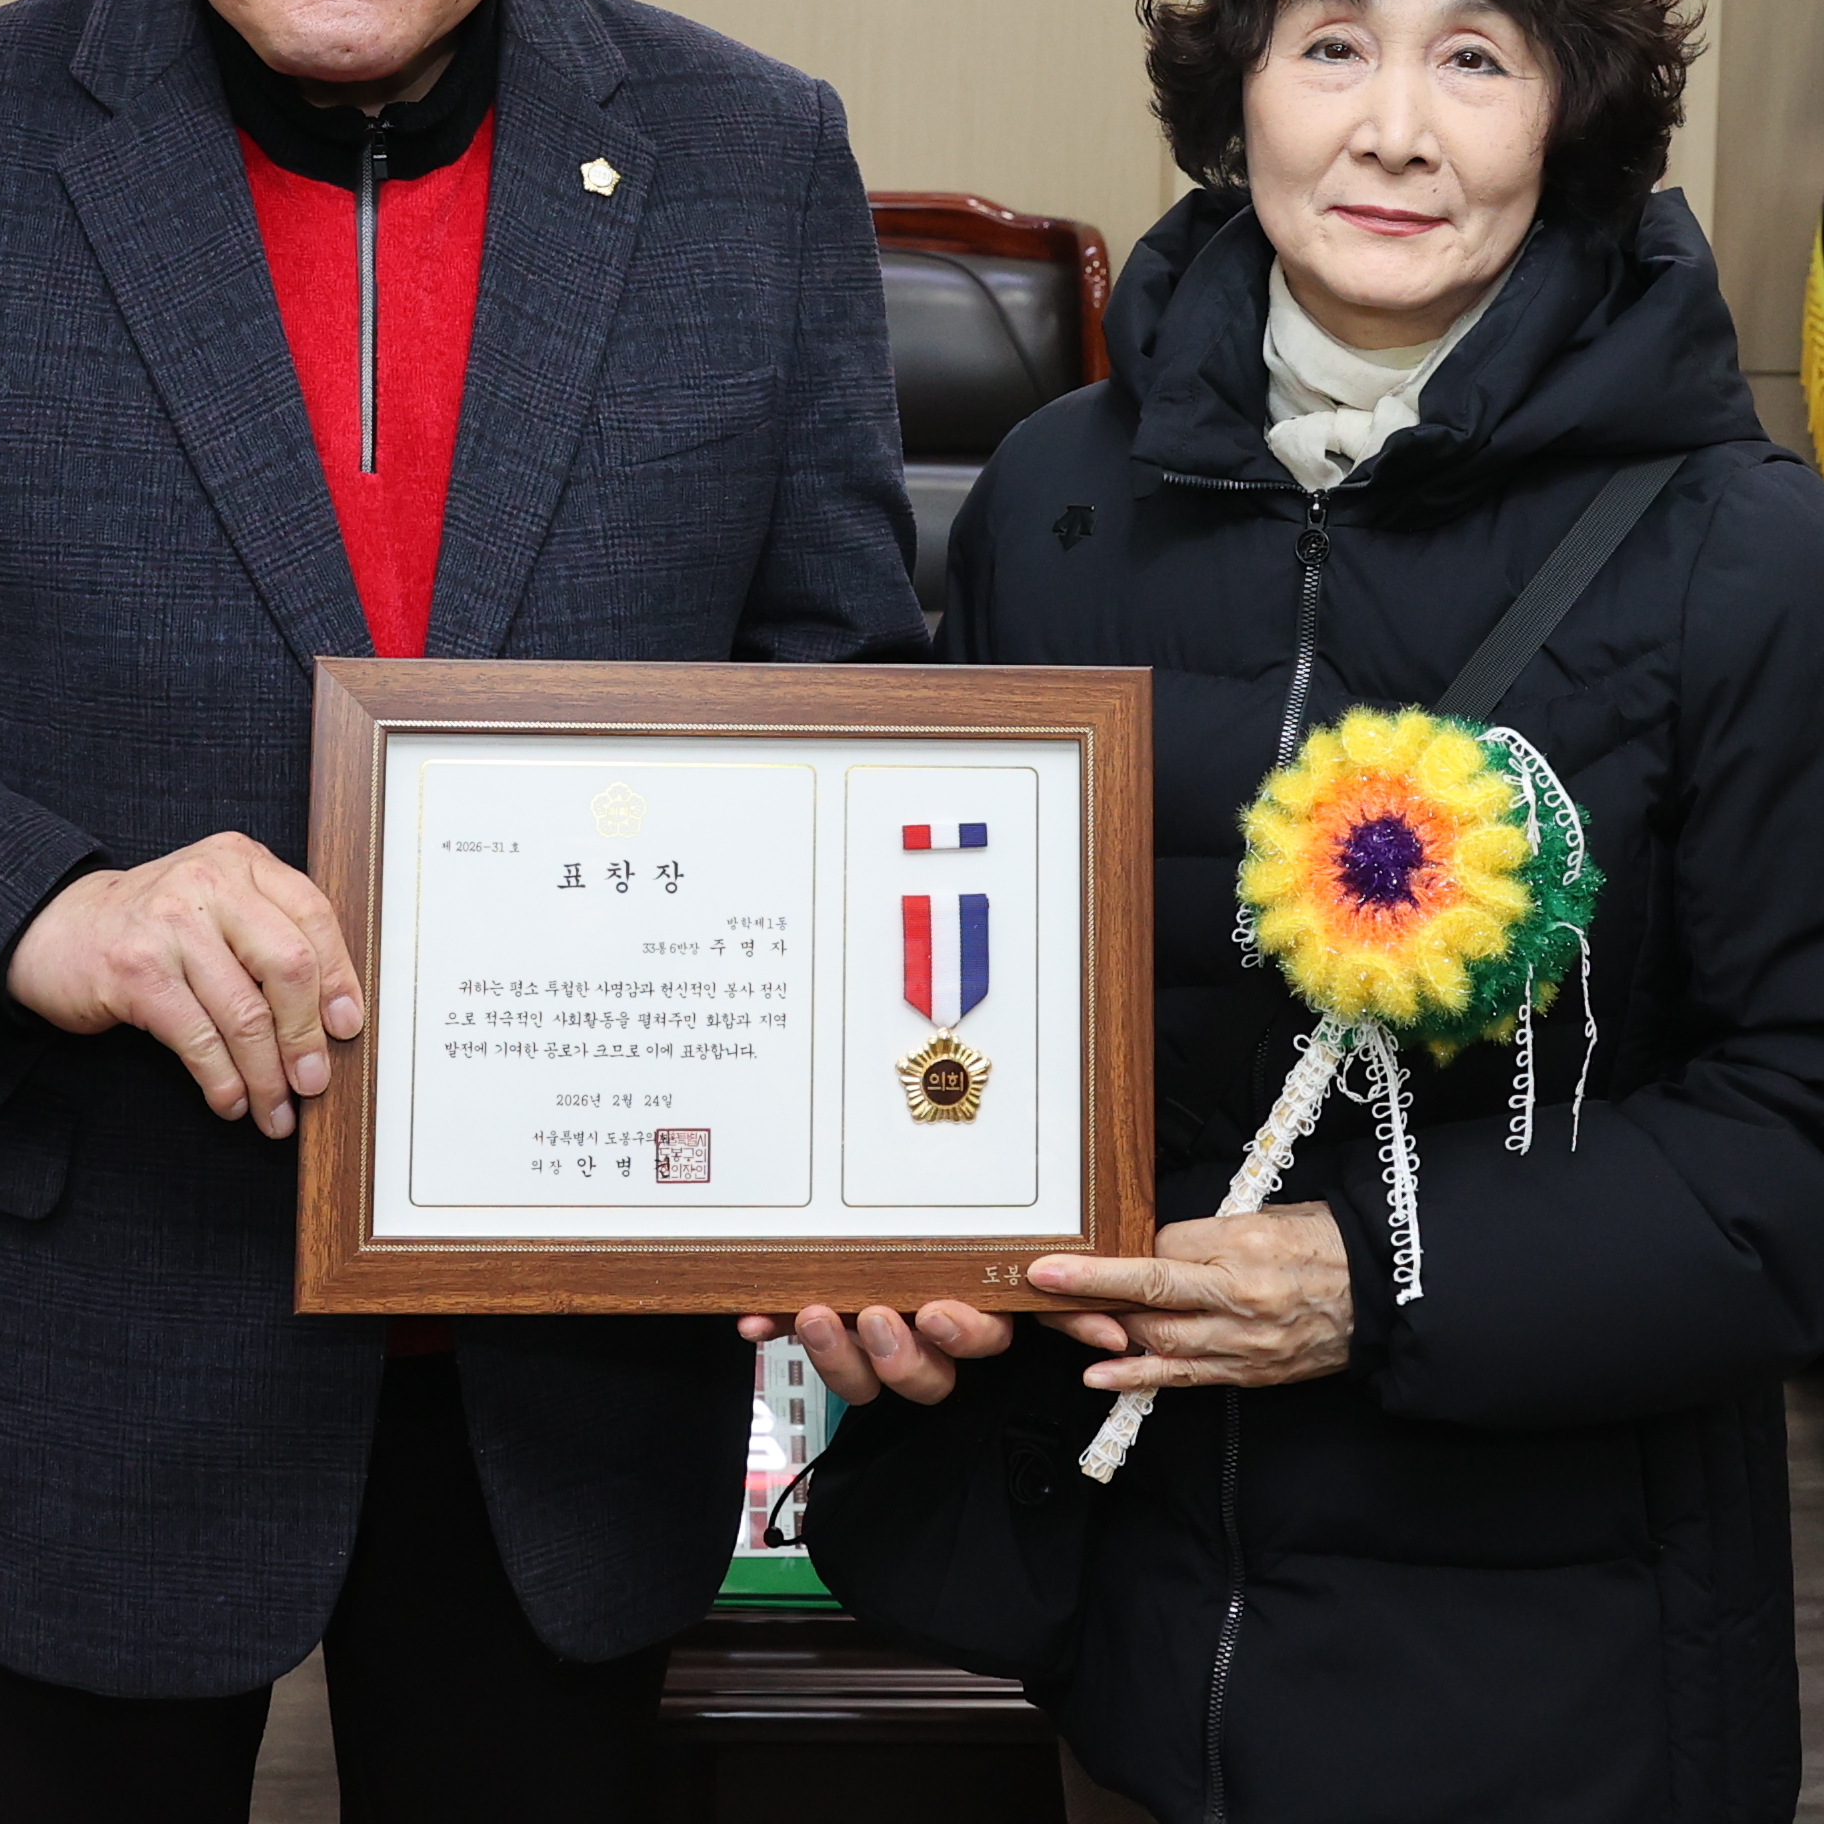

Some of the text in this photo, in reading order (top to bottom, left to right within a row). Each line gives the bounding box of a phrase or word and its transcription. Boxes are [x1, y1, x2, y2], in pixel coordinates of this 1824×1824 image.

[441, 840, 520, 853] 제 2026-31 호
[726, 916, 788, 931] 방학제1동
[459, 979, 788, 1000] 귀하는 평소 투철한 사명감과 헌신적인 봉사 정신
[444, 1011, 477, 1027] 으로
[484, 1010, 544, 1029] 적극적인
[552, 1010, 631, 1030] 사회활동을
[705, 1012, 752, 1030] 화합과
[758, 1012, 788, 1030] 지역
[444, 1040, 758, 1061] 발전에 기여한 공로가 크므로 이에 표창합니다.
[927, 1071, 964, 1092] 의회
[556, 1093, 673, 1109] 2026년 2월 24일
[532, 1130, 598, 1147] 서울특별시
[981, 1265, 1028, 1286] 도봉
